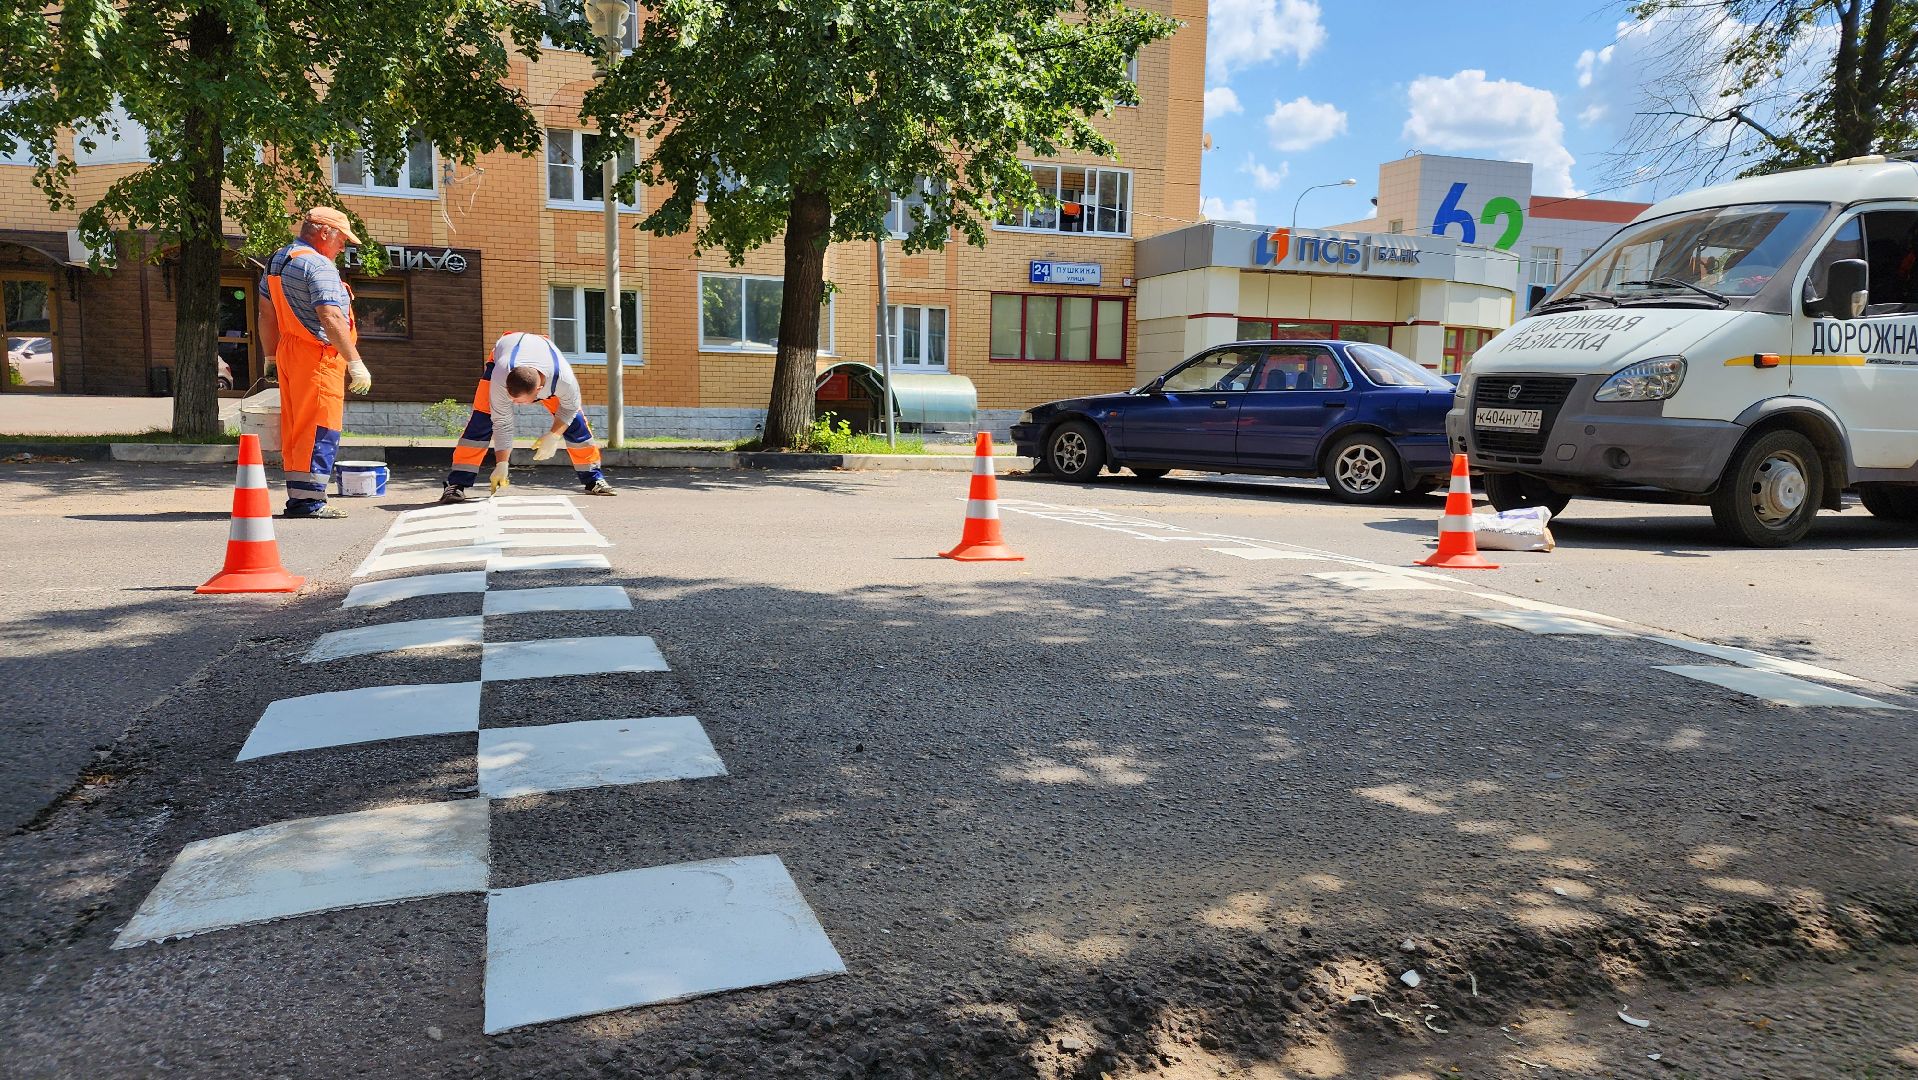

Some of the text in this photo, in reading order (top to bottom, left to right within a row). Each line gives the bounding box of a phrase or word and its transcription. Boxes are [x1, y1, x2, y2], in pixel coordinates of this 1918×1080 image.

[1431, 182, 1523, 251] 62
[1300, 236, 1421, 265] ПСБ БАНК
[1034, 264, 1049, 276] 24
[1056, 266, 1096, 275] ПУШКИНА
[1516, 314, 1645, 337] ДОРОЖНАЯ
[1499, 332, 1612, 352] РАЗМЕТКА
[1521, 411, 1538, 423] 777
